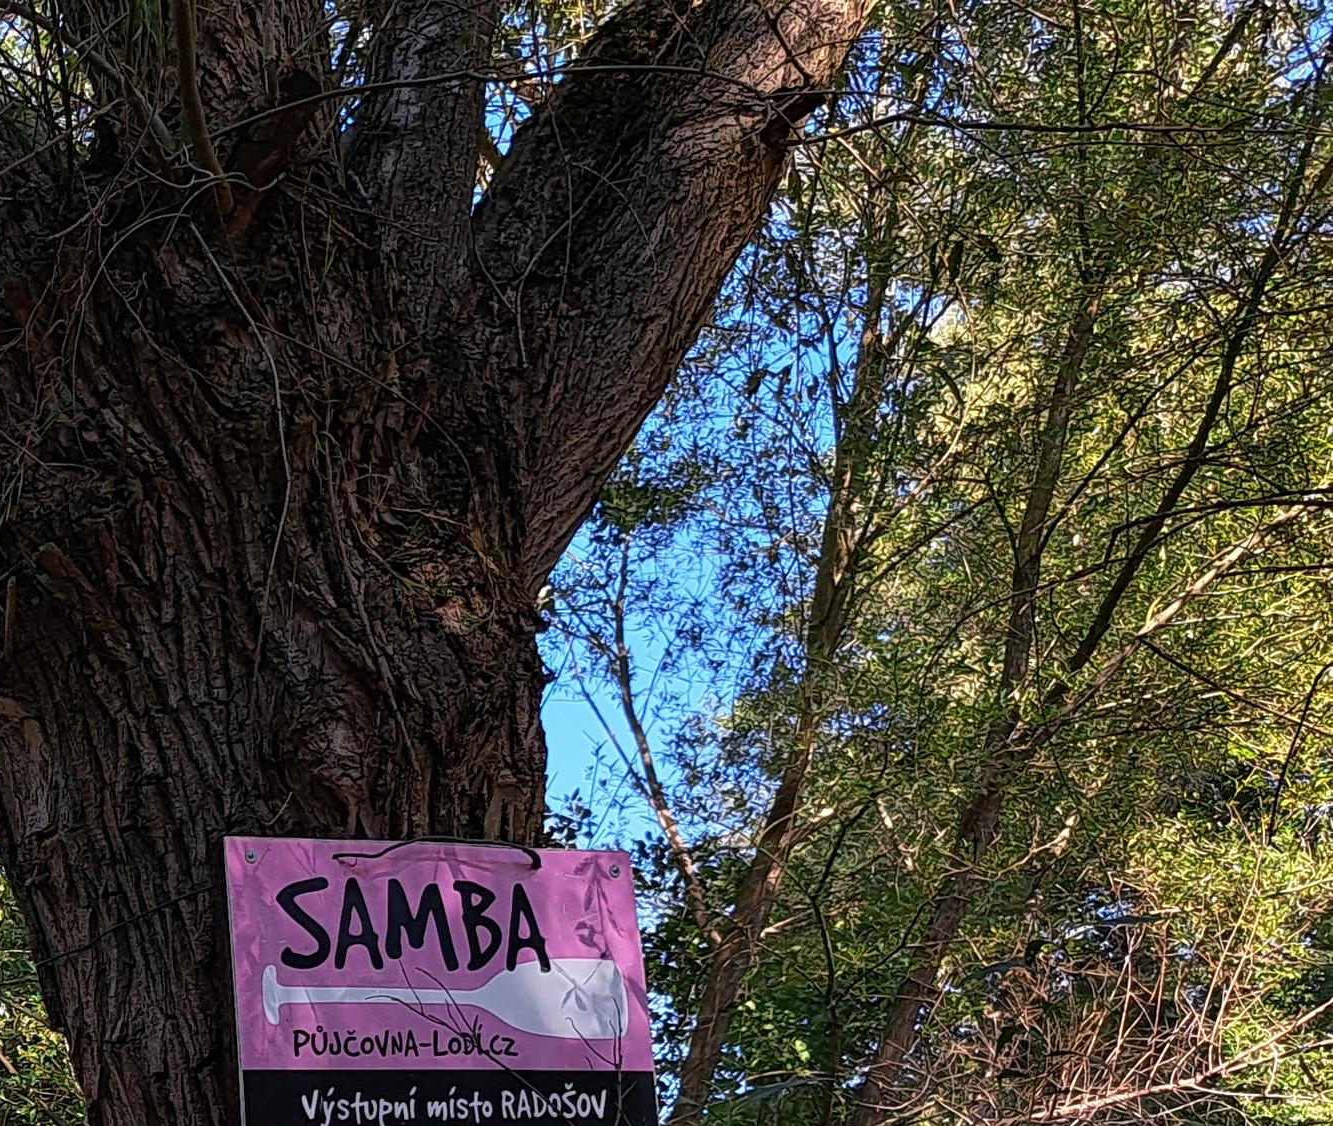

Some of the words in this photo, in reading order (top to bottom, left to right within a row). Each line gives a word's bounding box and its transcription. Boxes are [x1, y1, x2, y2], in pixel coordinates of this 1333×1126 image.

[276, 877, 551, 972] SAMBA
[427, 1087, 493, 1125] místo
[501, 1083, 607, 1121] RADOŠOV
